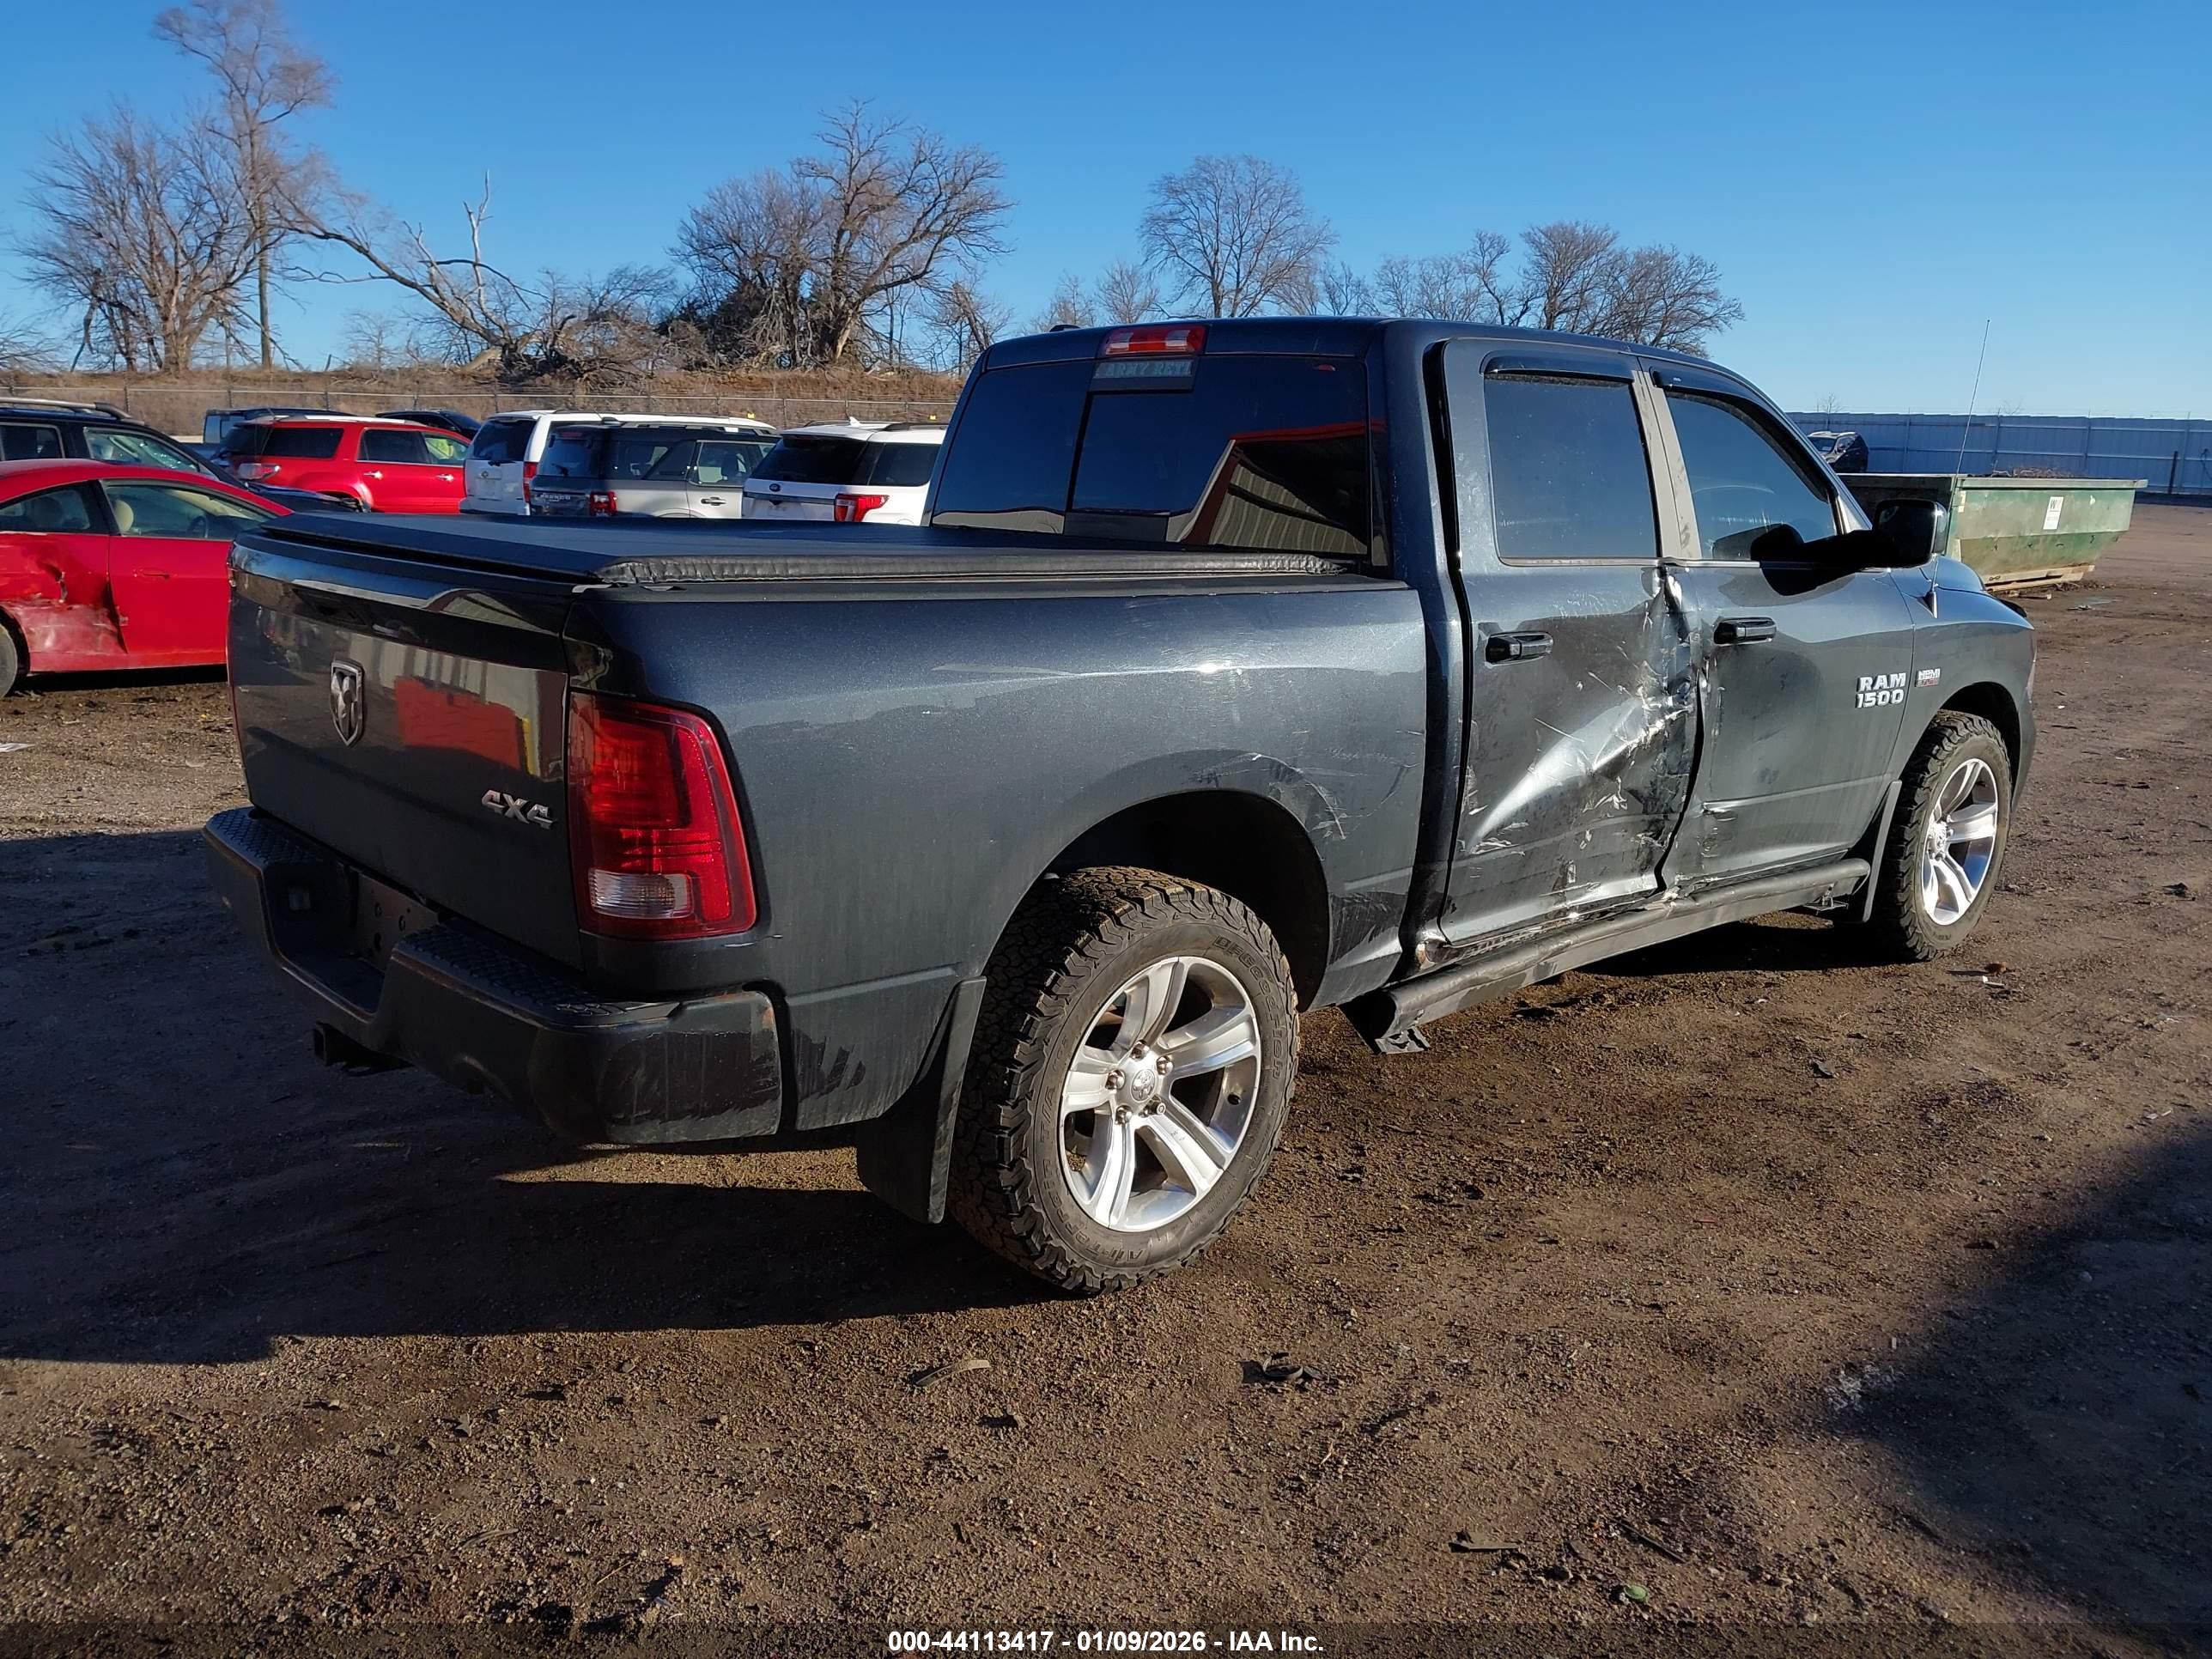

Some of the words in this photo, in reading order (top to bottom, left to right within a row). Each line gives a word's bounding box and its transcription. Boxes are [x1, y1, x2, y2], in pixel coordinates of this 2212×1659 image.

[1105, 362, 1150, 377] ARMY
[1858, 672, 1906, 692] RAM
[1917, 668, 1941, 681] HEMI
[1856, 689, 1905, 708] 1500
